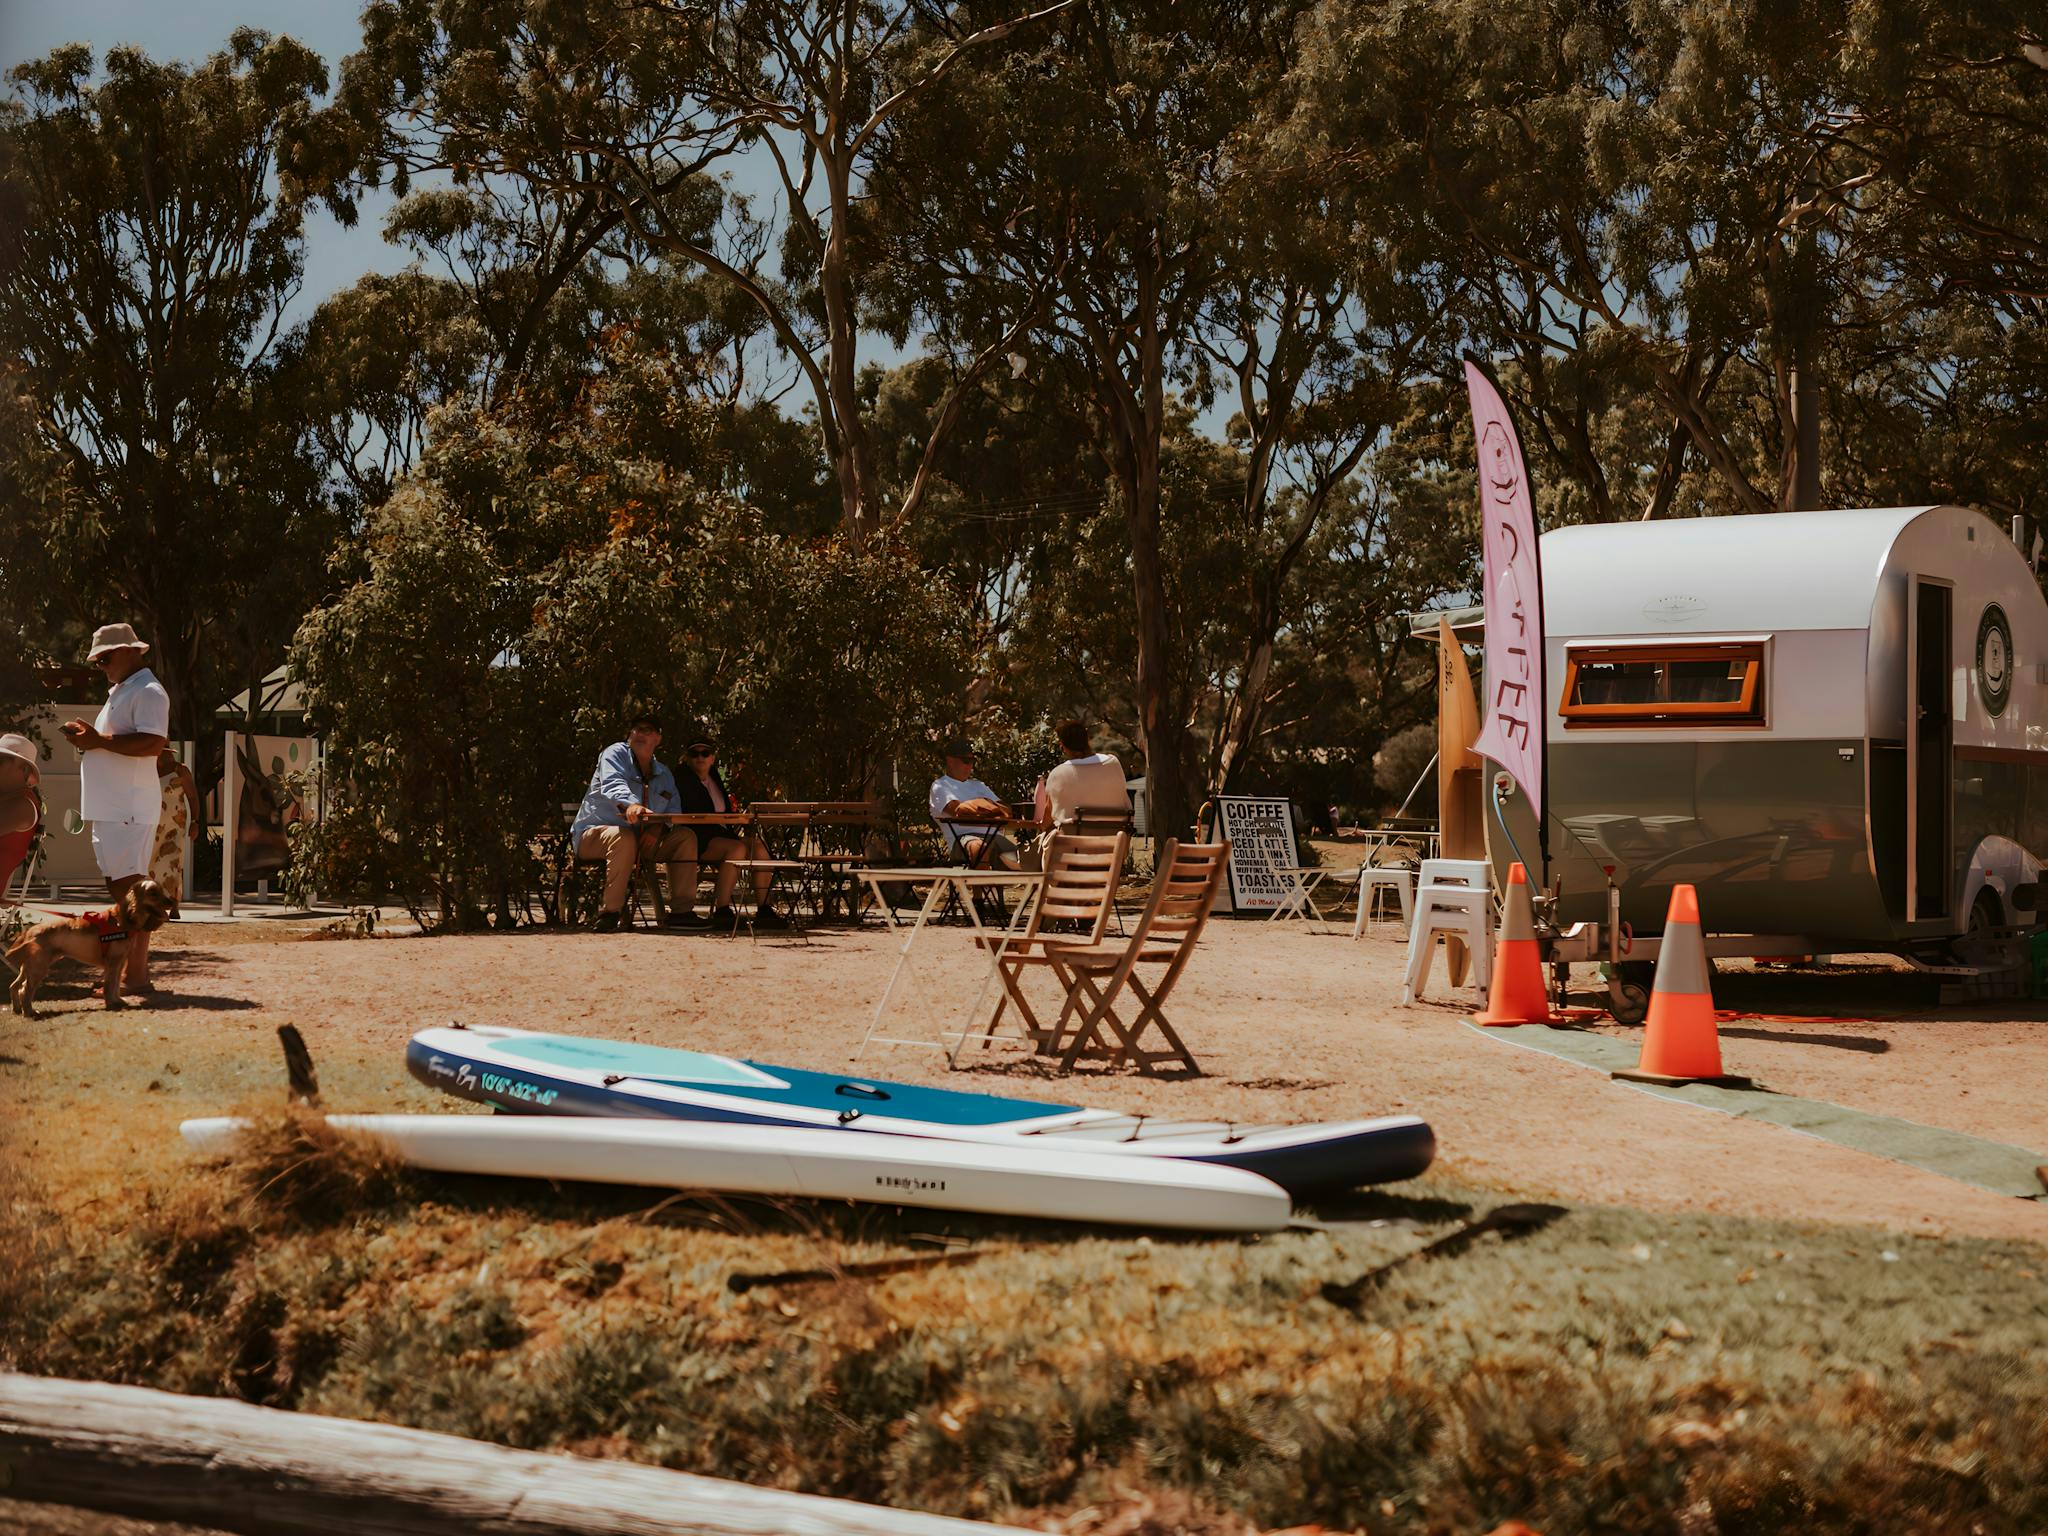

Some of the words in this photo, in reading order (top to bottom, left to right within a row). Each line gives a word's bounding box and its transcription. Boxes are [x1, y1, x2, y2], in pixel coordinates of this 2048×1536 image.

[1226, 803, 1284, 820] COFFEE
[1231, 838, 1255, 849] ICED
[1258, 839, 1290, 850] LATTE
[1233, 849, 1256, 859] COLD
[1258, 850, 1291, 860] DINKS
